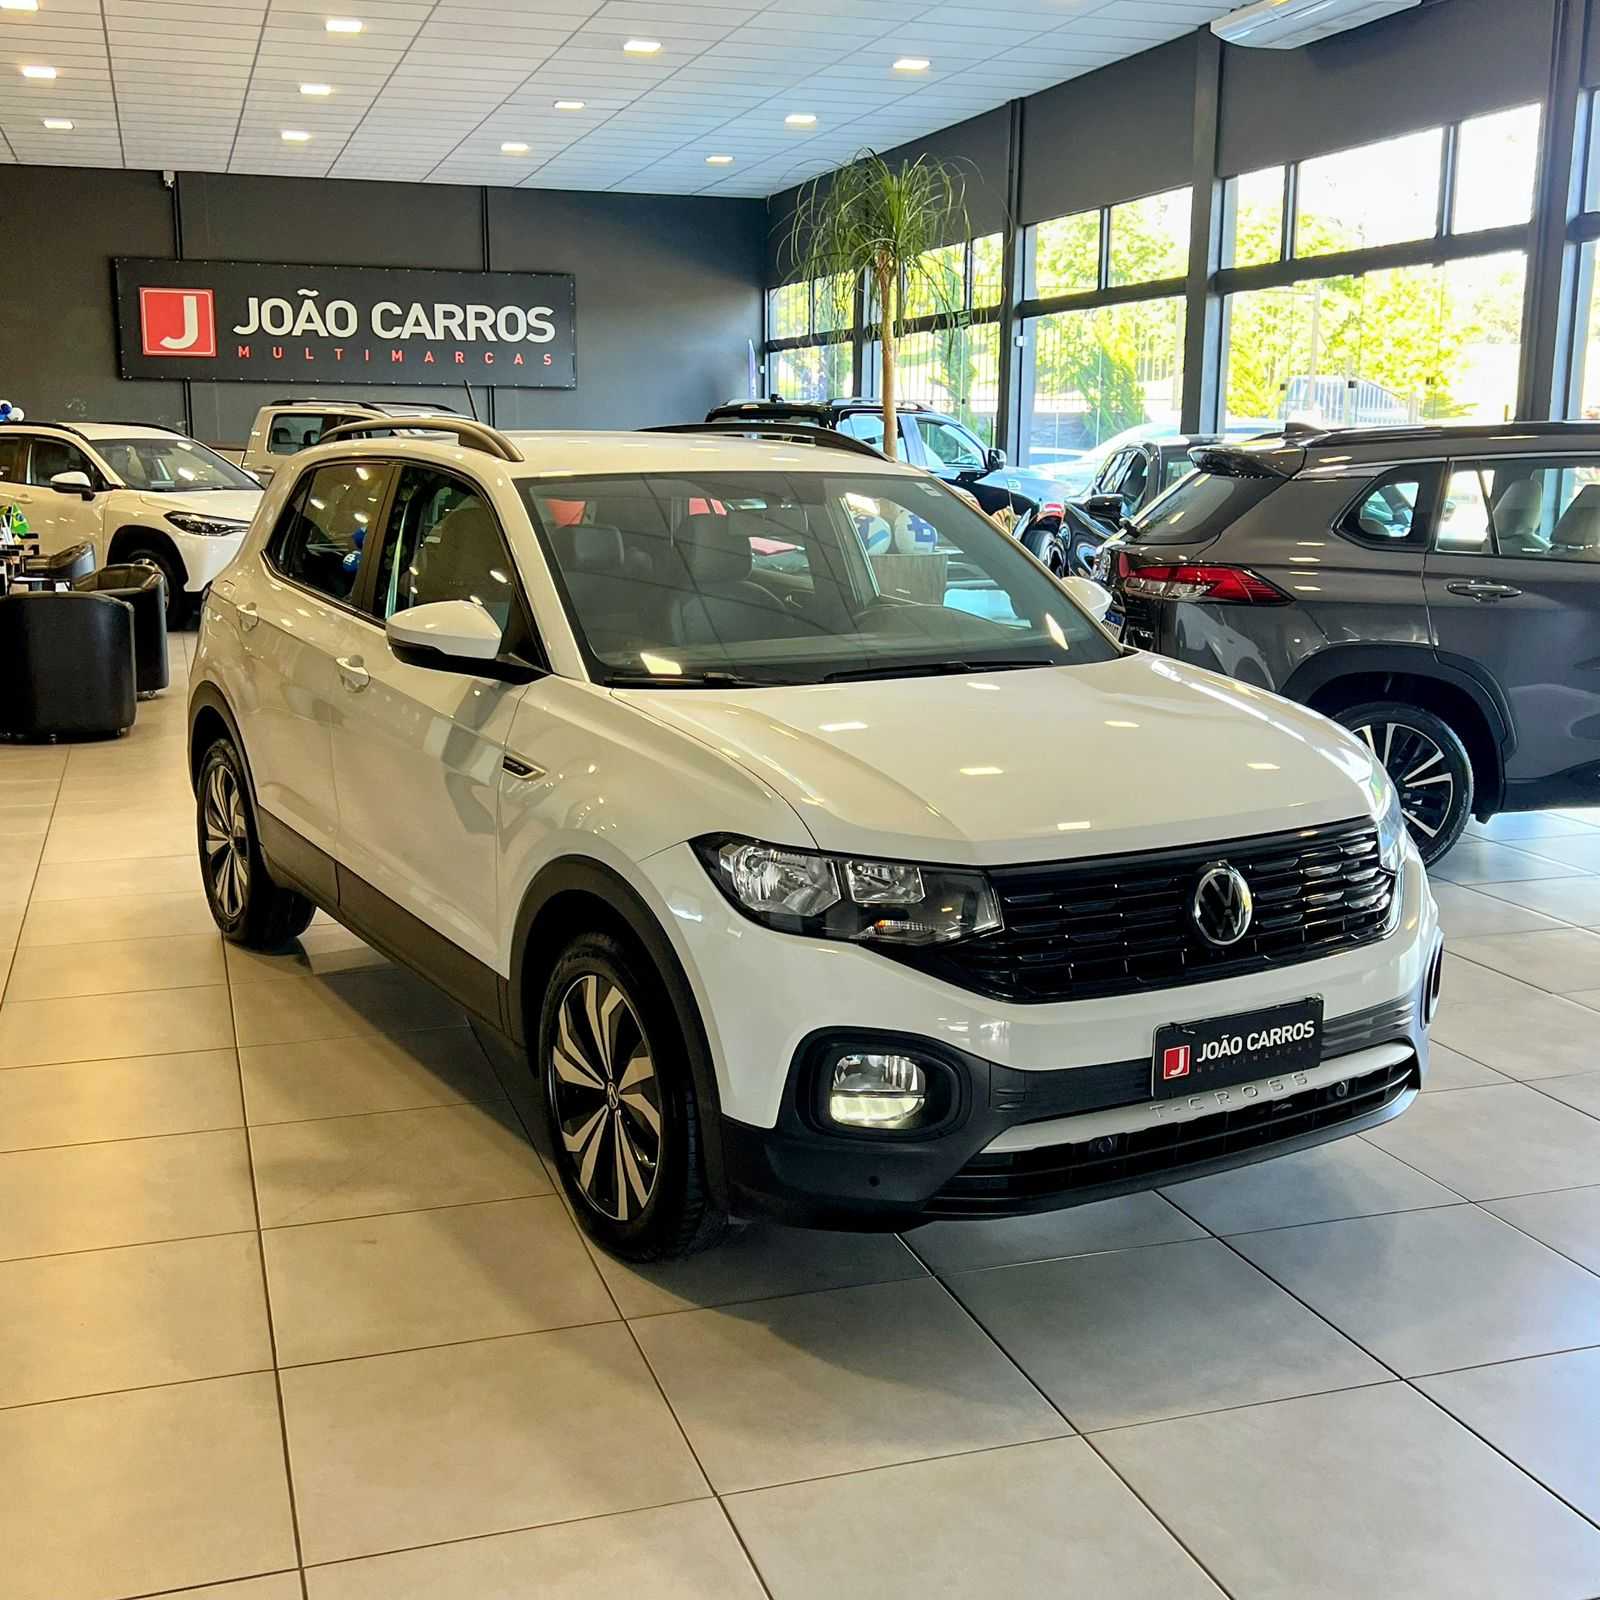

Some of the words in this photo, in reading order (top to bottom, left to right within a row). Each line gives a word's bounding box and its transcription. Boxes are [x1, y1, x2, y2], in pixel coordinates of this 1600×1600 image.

[159, 295, 198, 349] J
[232, 289, 358, 337] JOÃO
[371, 302, 556, 343] CARROS
[238, 345, 553, 366] MULTIMARCAS
[1169, 1048, 1185, 1076] J
[1196, 1034, 1243, 1062] JOÃO
[1246, 1020, 1315, 1051] CARROS
[1149, 1072, 1309, 1118] T-CROSS
